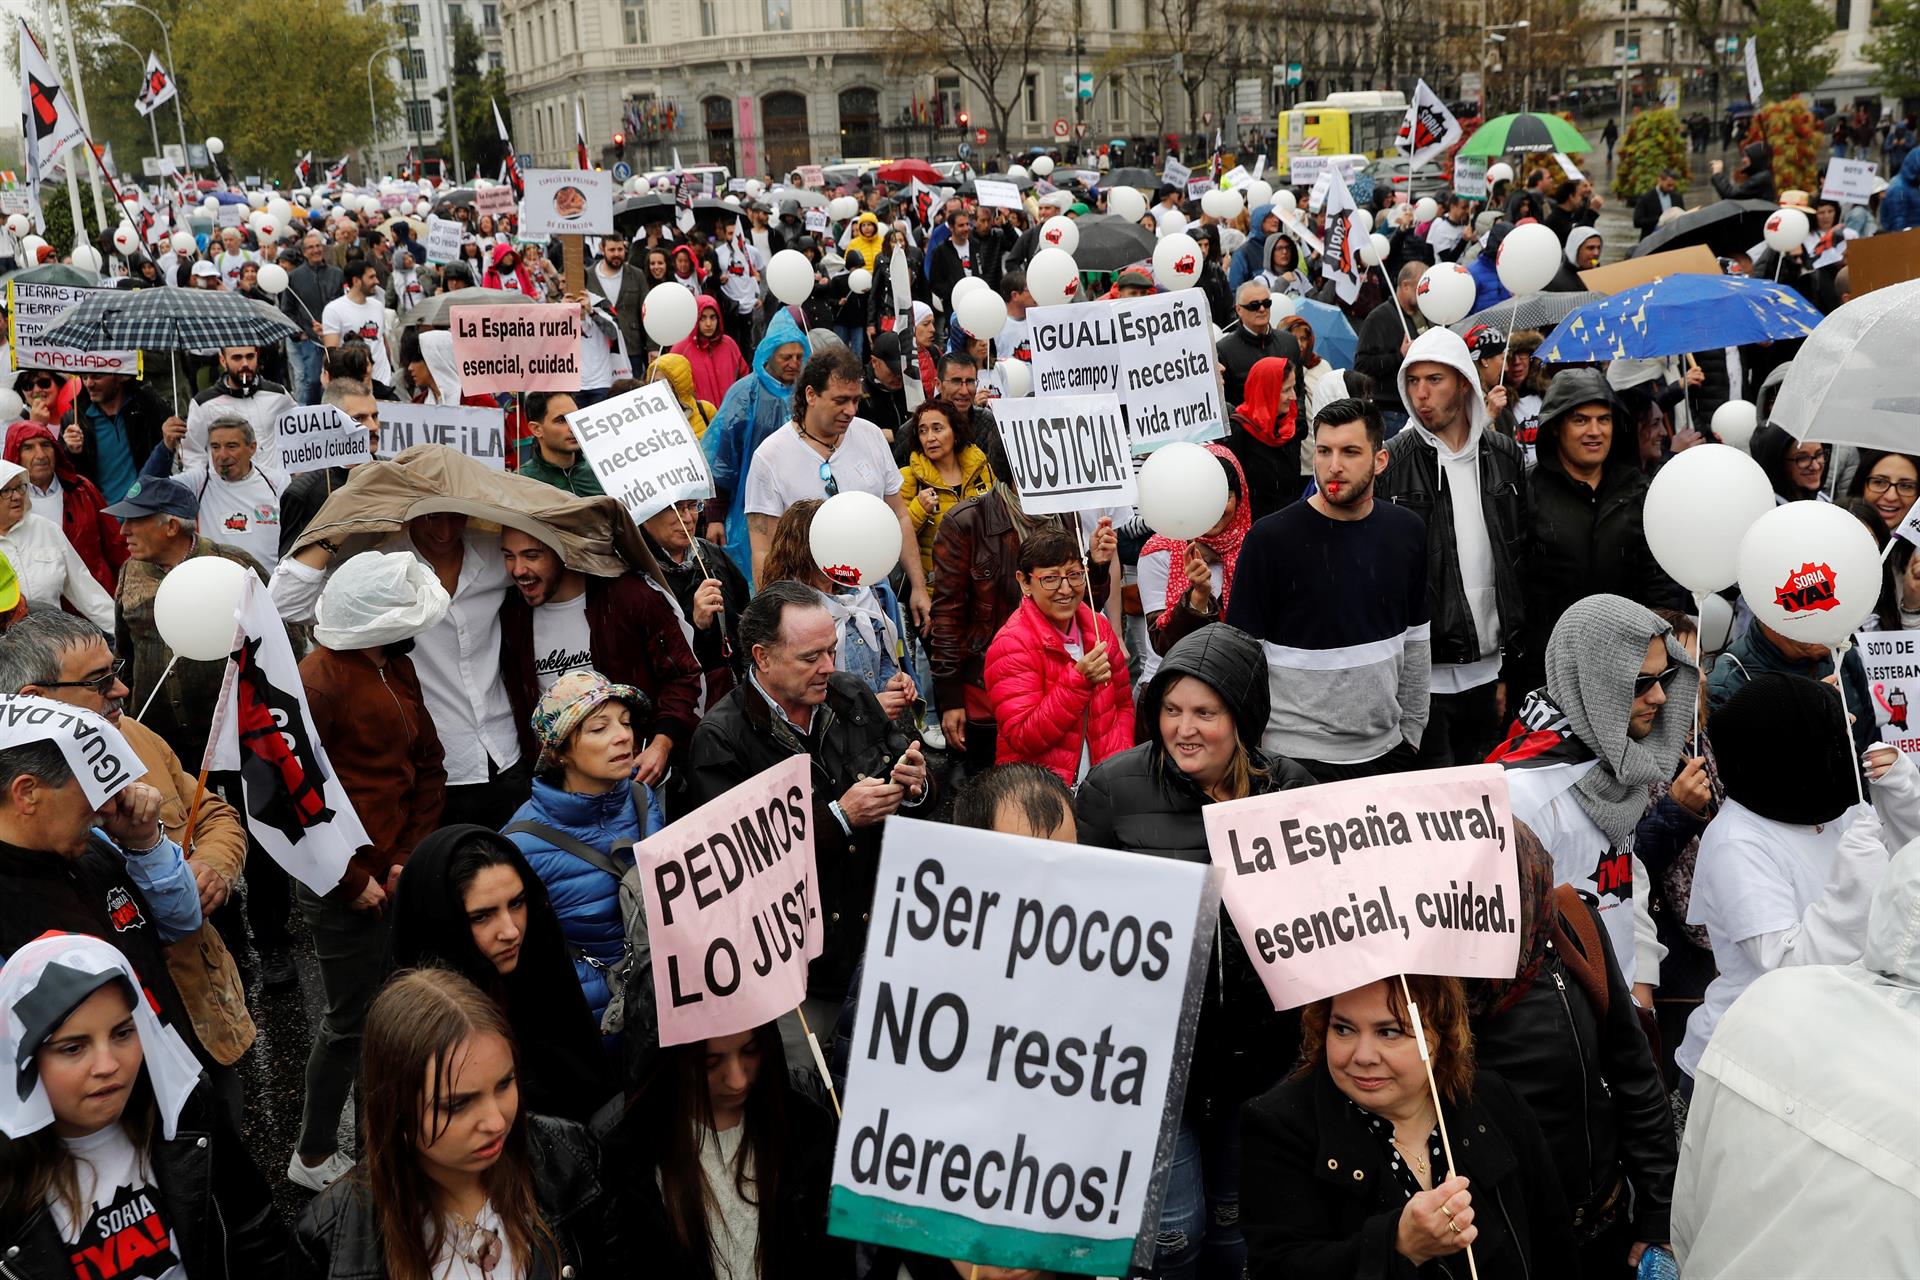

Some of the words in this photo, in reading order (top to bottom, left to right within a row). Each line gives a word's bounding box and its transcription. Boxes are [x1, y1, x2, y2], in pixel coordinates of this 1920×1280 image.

[1417, 108, 1443, 138] SORIA
[1513, 143, 1553, 152] DUNLOP
[430, 235, 440, 245] NO
[14, 283, 70, 301] TIERRAS
[16, 323, 44, 334] TAN
[459, 317, 477, 338] La
[481, 316, 535, 342] España
[539, 315, 577, 340] rural,
[1118, 301, 1201, 346] España
[34, 350, 122, 368] MACHADO
[462, 354, 525, 379] esencial,
[528, 352, 579, 375] cuidad.
[1041, 367, 1066, 392] entre
[1068, 364, 1108, 391] campo
[1111, 363, 1119, 390] y
[1127, 348, 1210, 390] necesita
[575, 395, 669, 442] España
[1136, 404, 1171, 437] vida
[1173, 392, 1217, 428] rural.
[282, 441, 322, 468] pueblo
[598, 428, 688, 477] necesita
[1000, 414, 1127, 490] ¡JUSTICIA!
[618, 478, 657, 512] vida
[656, 458, 705, 490] rural.
[834, 568, 855, 577] SORIA
[1793, 569, 1826, 589] SORIA
[1779, 580, 1835, 611] ¡YA!
[1867, 641, 1893, 656] SOTO
[1896, 640, 1914, 654] DE
[0, 703, 131, 795] IGUALDA
[654, 785, 807, 927] PEDIMOS
[1228, 828, 1276, 877] La
[1279, 804, 1413, 866] España
[1415, 794, 1506, 853] rural,
[884, 858, 1000, 958] ¡Ser
[1005, 897, 1174, 982] pocos
[1254, 885, 1410, 966] esencial,
[1415, 880, 1516, 934] cuidad.
[667, 937, 741, 1009] LO
[867, 981, 970, 1073] NO
[986, 1024, 1148, 1107] resta
[850, 1108, 1133, 1225] derechos!
[96, 1193, 157, 1239] SORIA
[70, 1211, 170, 1280] ¡YA!
